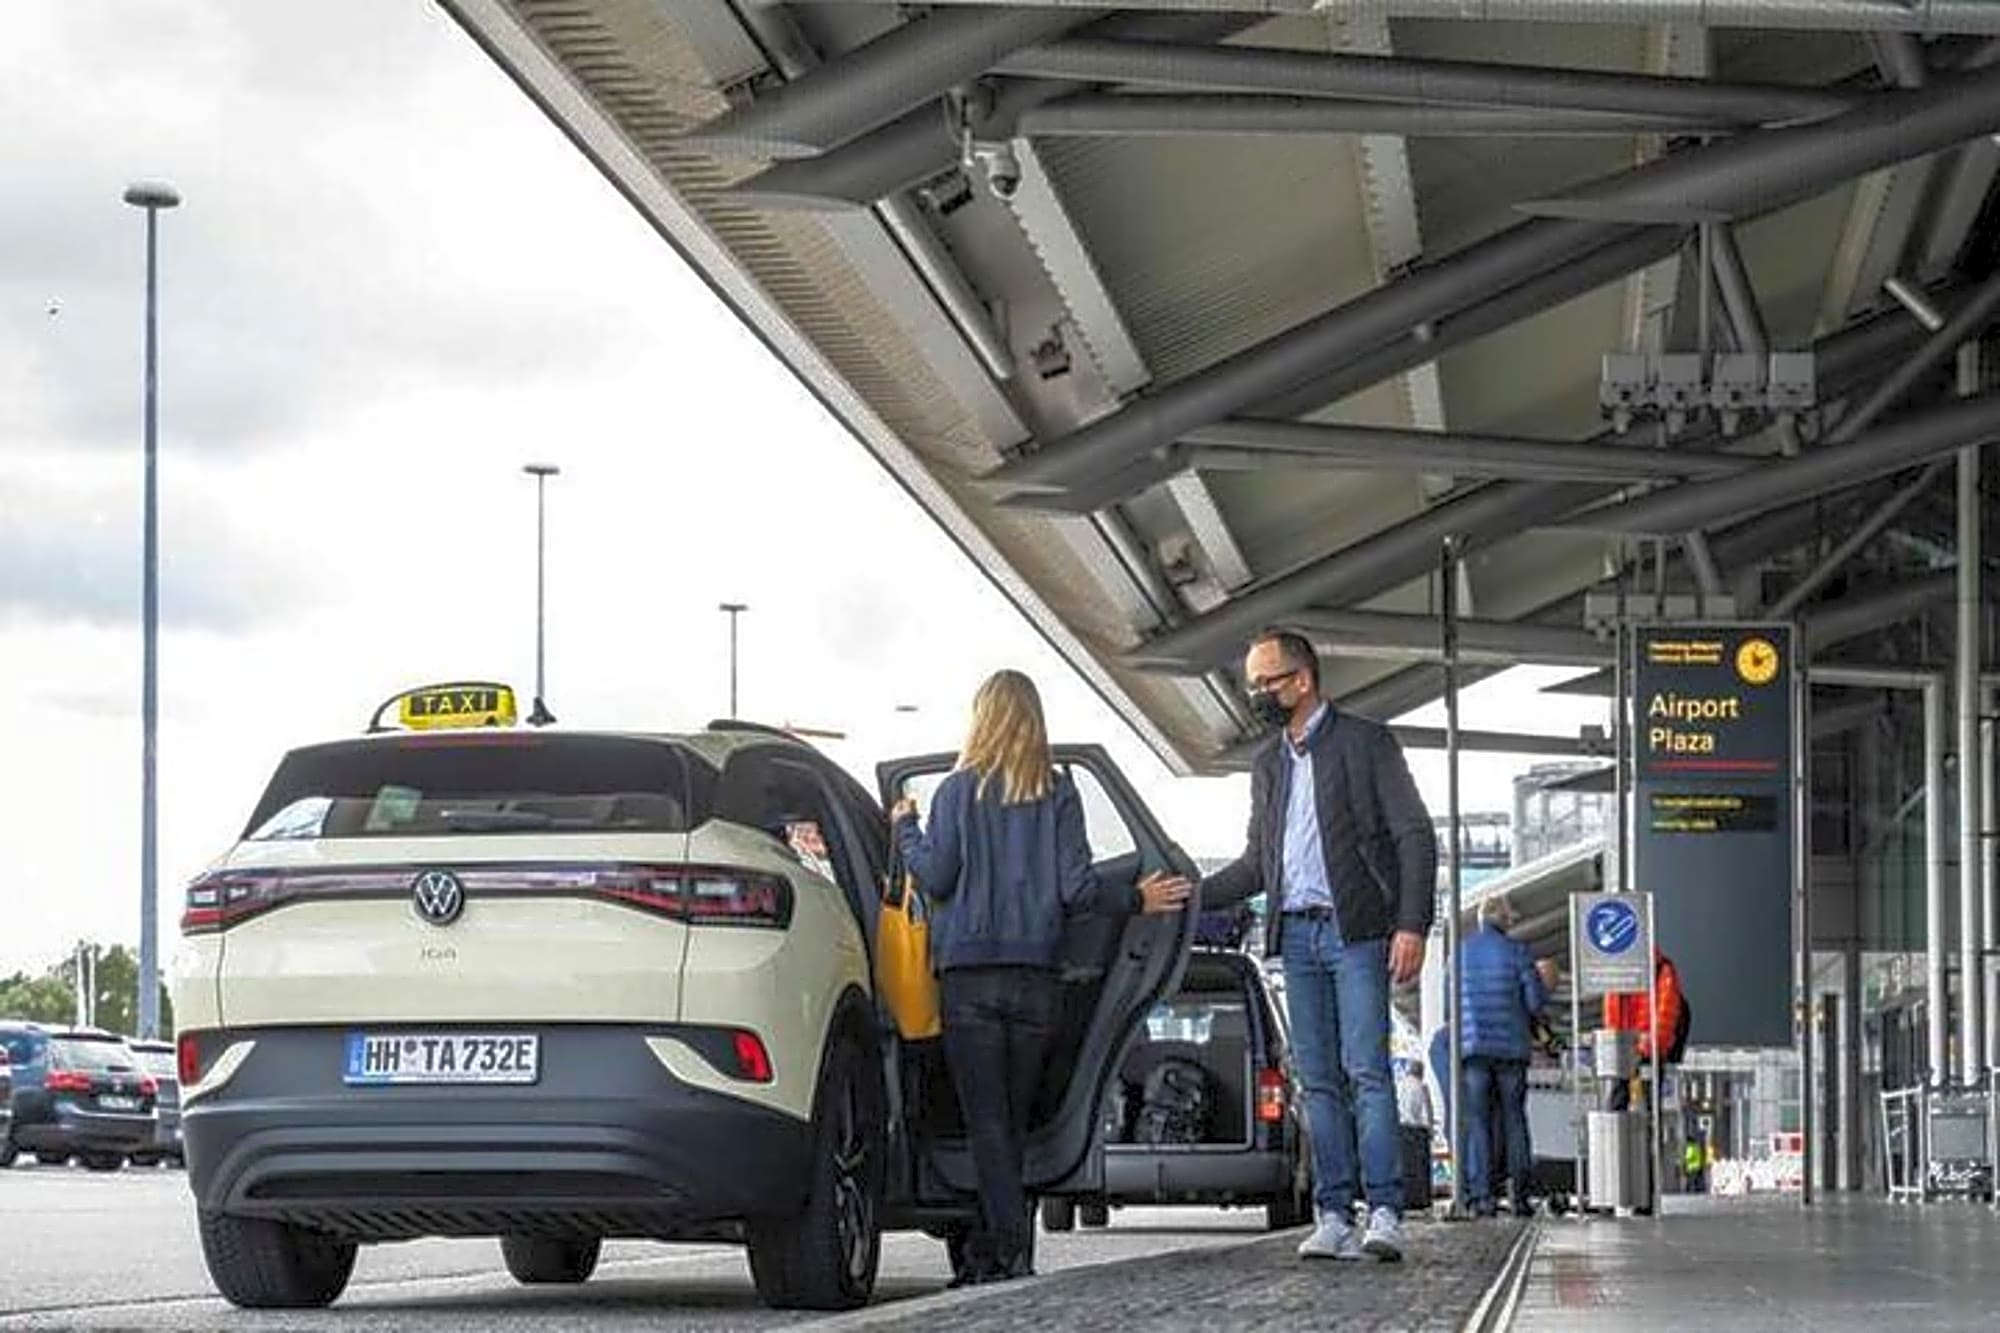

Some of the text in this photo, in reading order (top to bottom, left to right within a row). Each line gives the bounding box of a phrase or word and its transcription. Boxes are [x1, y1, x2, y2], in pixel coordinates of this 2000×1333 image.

[422, 693, 487, 713] TAXI
[1649, 693, 1739, 722] Airport
[1650, 727, 1714, 752] Plaza
[365, 1039, 401, 1072] HH
[421, 1039, 456, 1071] TA
[462, 1039, 533, 1071] 732E
